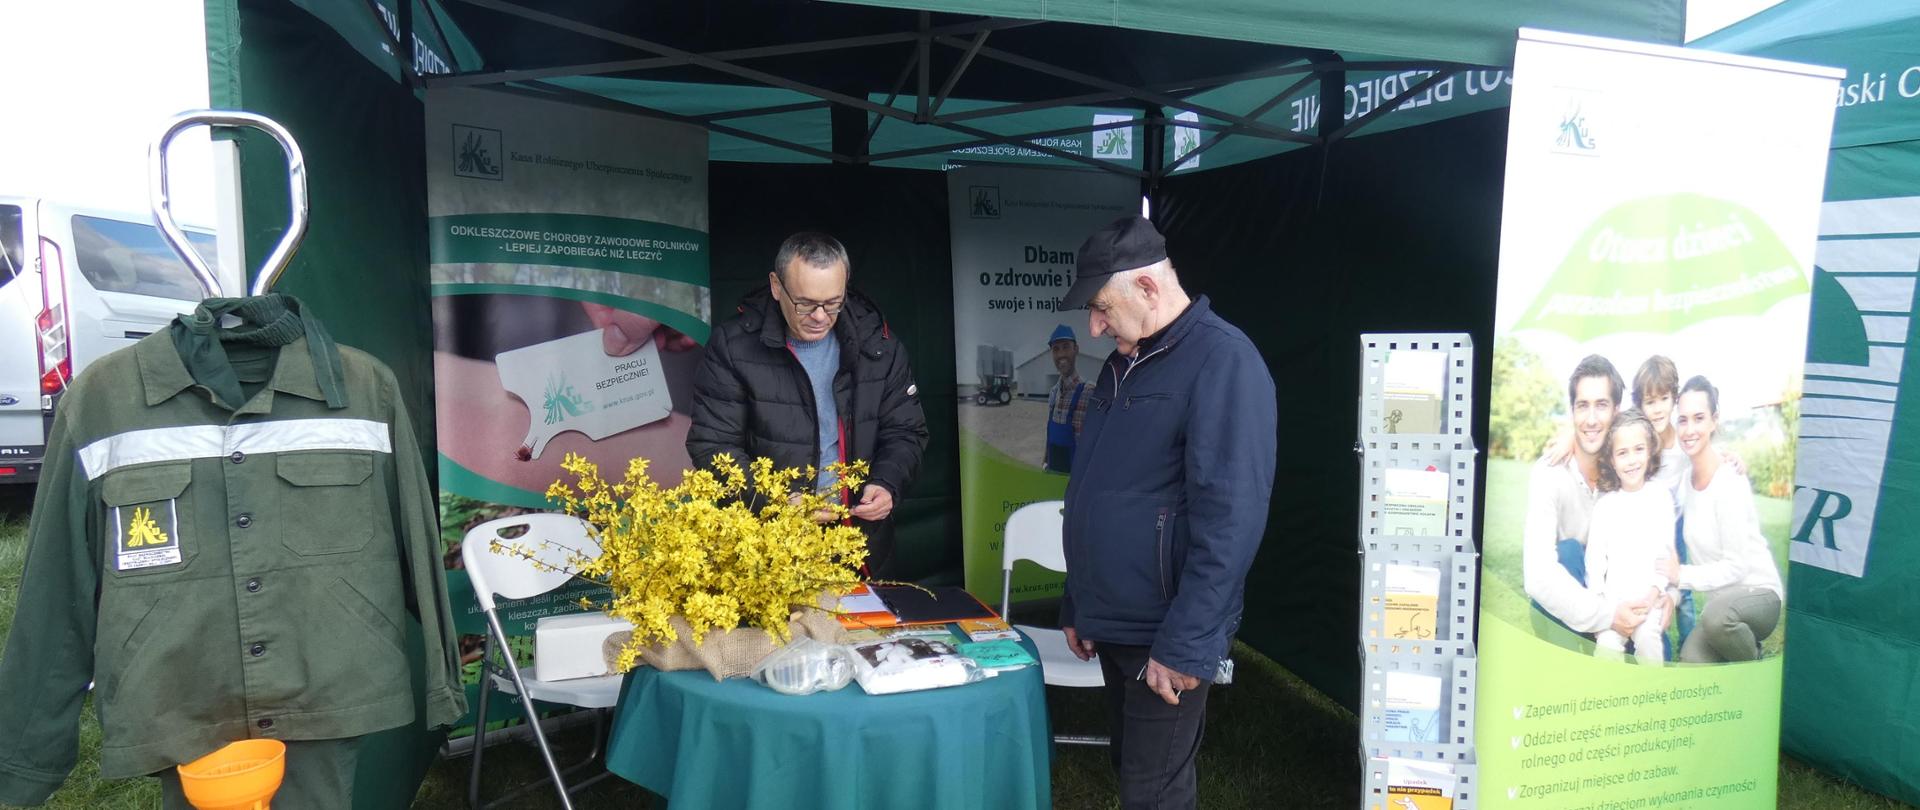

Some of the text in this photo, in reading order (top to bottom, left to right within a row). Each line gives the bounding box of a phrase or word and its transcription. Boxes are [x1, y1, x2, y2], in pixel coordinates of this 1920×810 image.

[451, 225, 699, 252] ODKLESZCZOWE CHOROBY ZAWODOWE ROLNIKÓW
[505, 243, 542, 254] LEPIEJ
[543, 244, 608, 258] ZAPOBIEGAĆ
[609, 248, 625, 259] NIŻ
[626, 250, 663, 261] LECZYĆ
[1024, 246, 1075, 265] Dbam
[980, 268, 1072, 288] o zdrowie i
[988, 298, 1025, 313] swoje
[595, 368, 649, 390] BEZPIECZNIE!
[615, 358, 647, 373] PRACUJ
[1790, 485, 1852, 551] R
[1525, 682, 1722, 719] Zapewnij dzieciom opiekę dorosłych.
[1523, 708, 1743, 748] Oddziel część mieszkalną gospodarstwa
[1522, 735, 1696, 769] rolnego od części produkcyjnej.
[1519, 764, 1680, 799] Zorganizuj miejsce do zabaw.
[1648, 786, 1704, 807] wykonania
[1705, 778, 1757, 799] czynności
